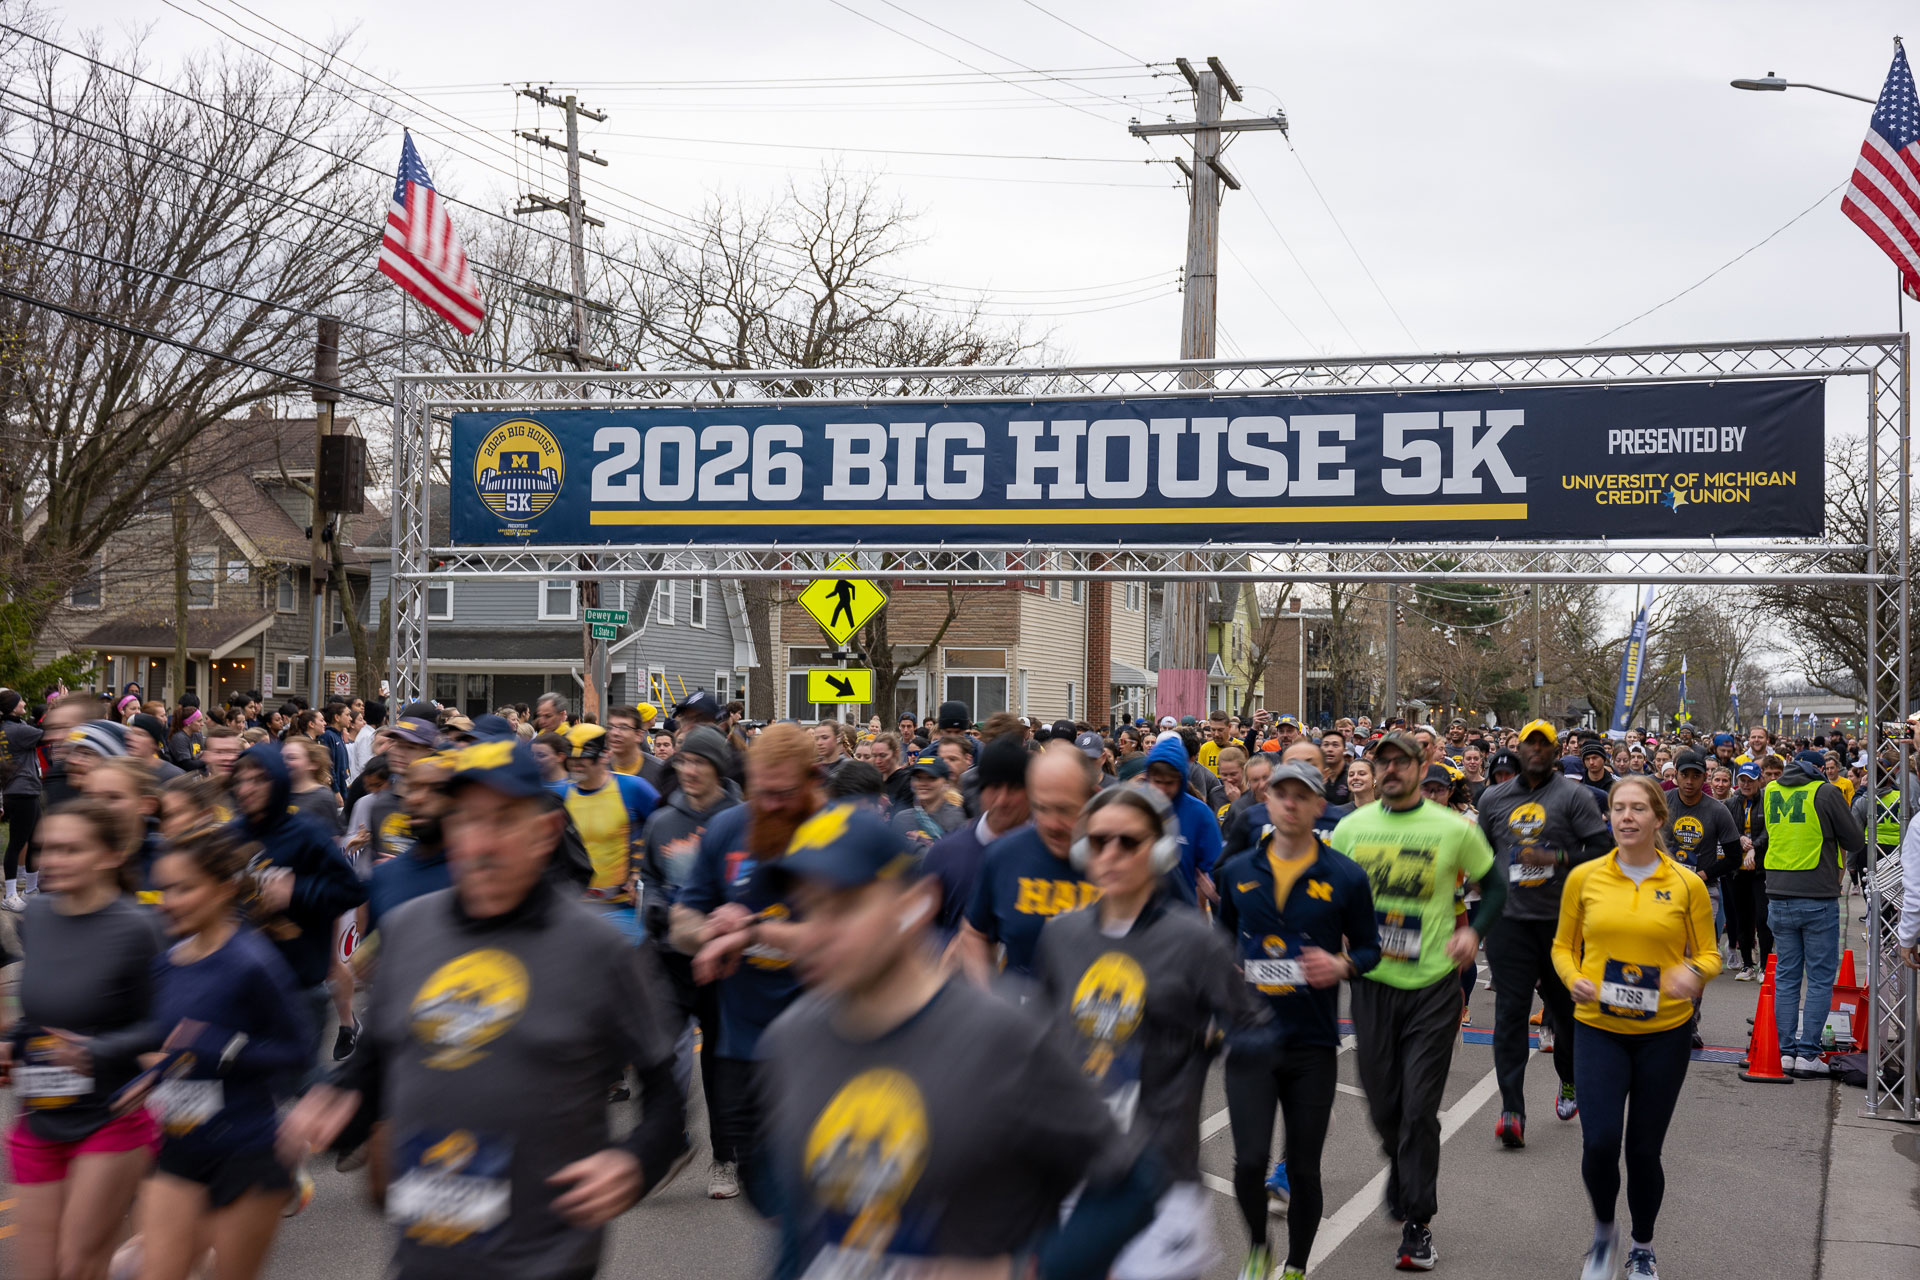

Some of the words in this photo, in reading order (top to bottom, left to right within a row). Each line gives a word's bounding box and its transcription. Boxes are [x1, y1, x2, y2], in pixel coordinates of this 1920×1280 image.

[484, 431, 507, 457] 2026
[507, 426, 525, 438] BIG
[526, 427, 555, 456] HOUSE
[1608, 427, 1718, 455] PRESENTED
[1720, 426, 1747, 453] BY
[511, 454, 529, 468] M
[590, 425, 804, 502] 2026
[823, 422, 986, 501] BIG
[1006, 413, 1356, 500] HOUSE
[1381, 409, 1528, 496] 5K
[1562, 473, 1670, 490] UNIVERSITY
[1674, 472, 1700, 488] OF
[1704, 471, 1796, 487] MICHIGAN
[506, 493, 531, 512] 5K
[1595, 489, 1662, 505] CREDIT
[1690, 487, 1750, 504] UNION
[587, 610, 611, 622] Dewey
[614, 613, 626, 621] Ave
[1769, 790, 1808, 824] M
